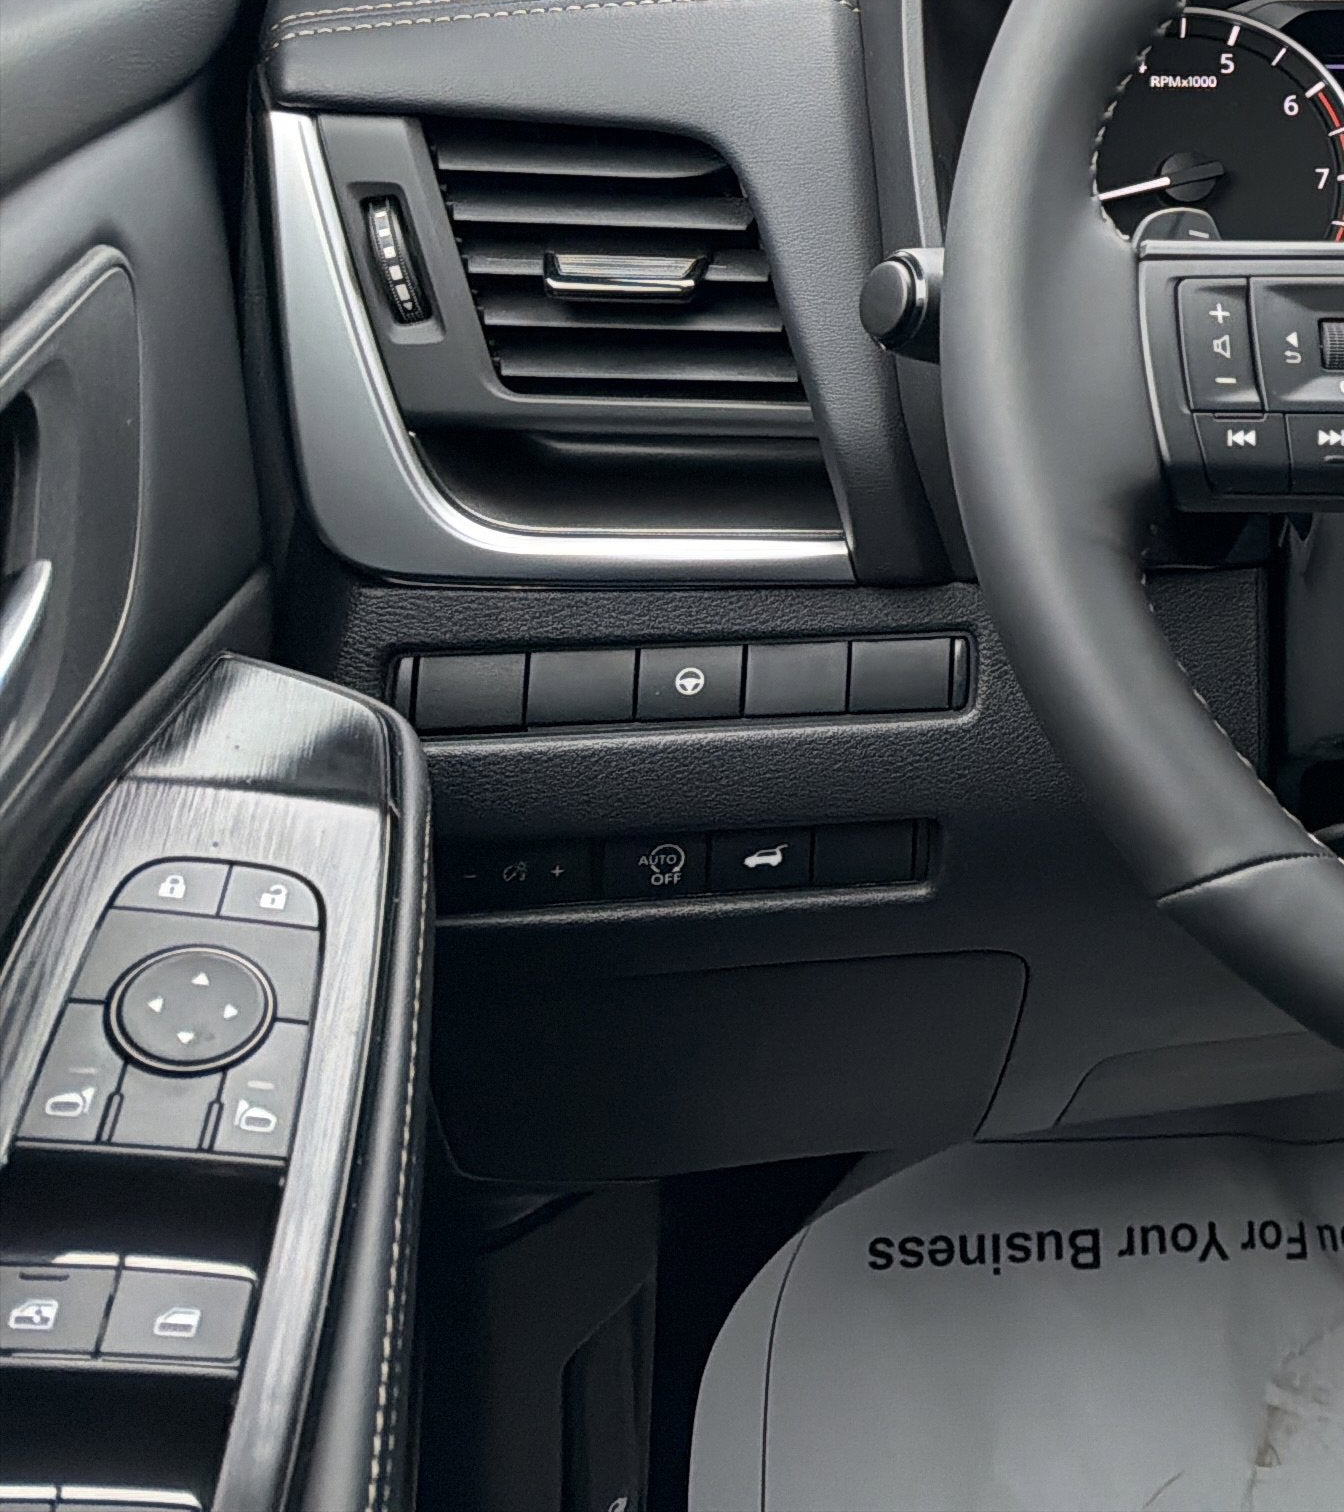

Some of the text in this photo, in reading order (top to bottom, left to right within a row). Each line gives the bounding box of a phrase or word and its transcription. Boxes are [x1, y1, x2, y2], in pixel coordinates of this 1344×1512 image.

[1220, 53, 1235, 74] 5
[1150, 75, 1217, 88] RPMx1000
[1283, 95, 1299, 116] 6
[1314, 168, 1329, 190] 7
[638, 854, 677, 866] AUTO
[651, 873, 682, 886] OFF
[1117, 1220, 1230, 1263] Your
[1241, 1220, 1308, 1260] For
[868, 1228, 1101, 1276] Business
